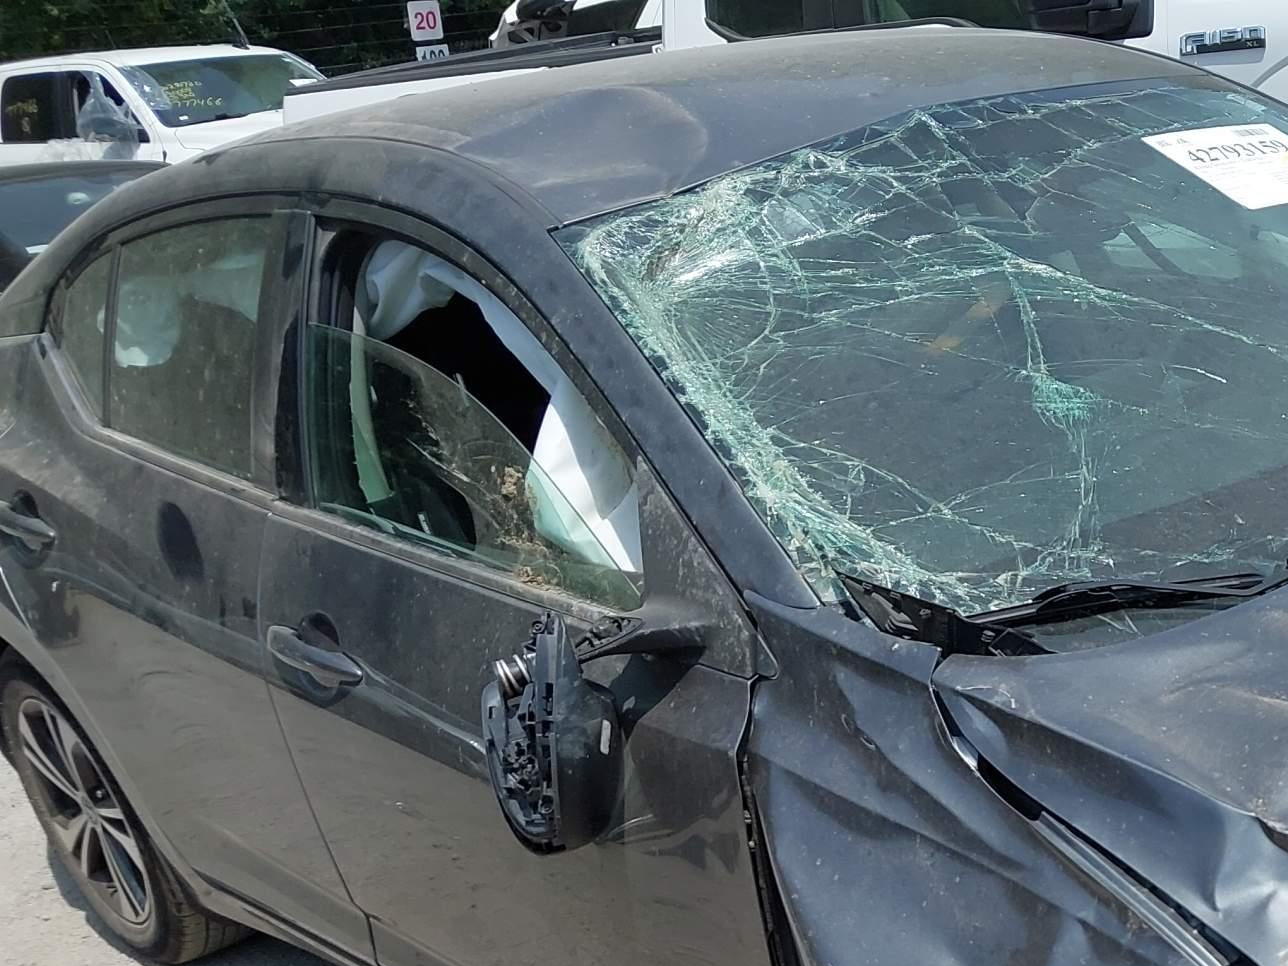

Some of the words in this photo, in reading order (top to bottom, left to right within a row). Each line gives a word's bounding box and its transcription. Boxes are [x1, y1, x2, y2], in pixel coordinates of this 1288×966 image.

[414, 10, 437, 31] 20
[1245, 40, 1261, 48] XL
[1187, 139, 1288, 163] 42793159
